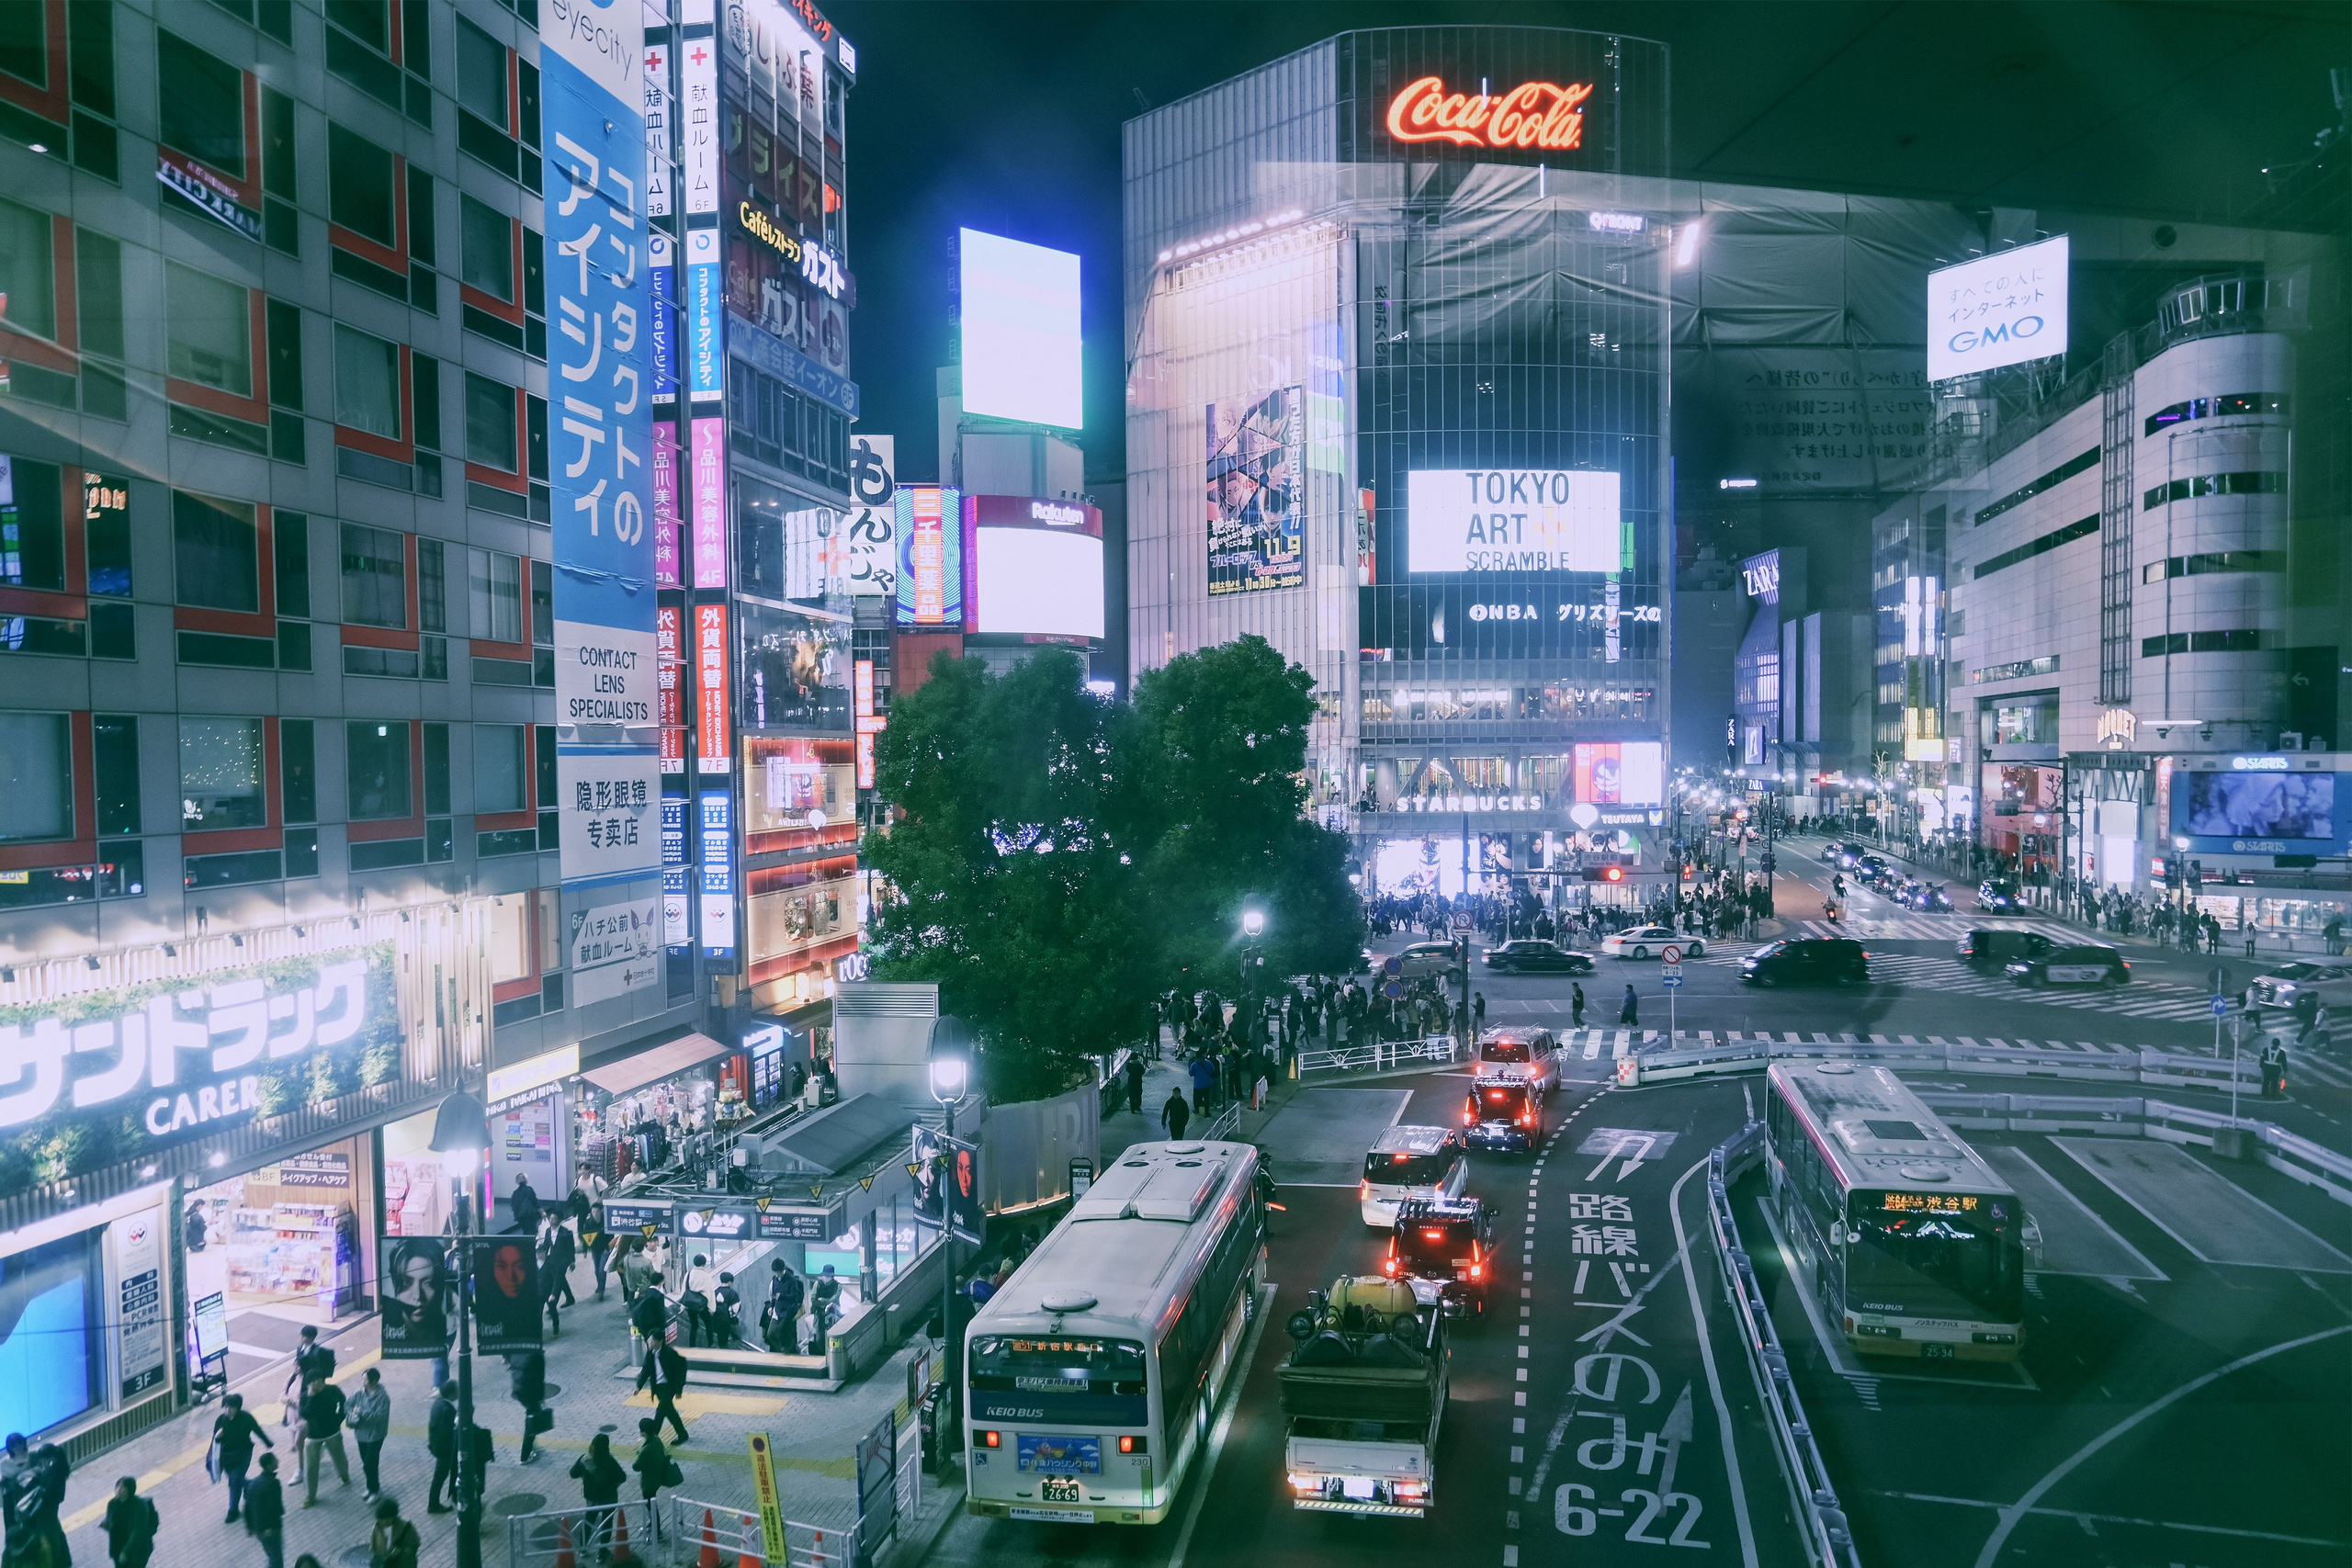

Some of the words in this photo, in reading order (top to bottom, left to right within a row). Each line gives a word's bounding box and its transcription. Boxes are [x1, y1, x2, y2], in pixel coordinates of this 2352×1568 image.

[551, 0, 632, 81] eyecity
[1387, 76, 1593, 148] Coca-Cola
[691, 84, 709, 190] 献血ルーム
[695, 199, 709, 210] 6F
[740, 201, 800, 263] Caféレストラン
[802, 240, 845, 299] ガスト
[1950, 268, 2044, 303] すべての人に
[761, 278, 815, 349] ガスト
[1949, 288, 2044, 322] インターネット
[555, 131, 607, 536] アイシティ
[698, 267, 713, 387] コンタクトのアイシティ
[1949, 316, 2044, 353] GMO
[607, 167, 642, 546] コンタクトの
[752, 333, 838, 399] 英会話イーオン
[700, 392, 712, 400] 5F
[1465, 472, 1569, 505] TOKYO
[700, 448, 718, 562] 品川美容外科
[851, 438, 895, 592] もんじゃ
[1032, 502, 1084, 525] Rakuten
[1465, 513, 1528, 545] ART
[1210, 551, 1257, 567] ブルーロック
[1465, 551, 1569, 571] SCRAMBLE
[700, 570, 721, 582] 4F
[1743, 564, 1779, 596] ZARA
[1489, 604, 1538, 620] NBA
[580, 646, 637, 670] CONTACT
[701, 608, 722, 689] 外貨両替
[594, 674, 625, 694] LENS
[570, 698, 648, 720] SPECIALISTS
[714, 690, 722, 716] MONEY
[714, 717, 723, 757] EXCHANGE
[1727, 718, 1736, 746] ZARA
[706, 760, 723, 772] 7F
[576, 779, 647, 812] 隐形眼镜
[1748, 779, 1764, 790] ZARA
[1396, 796, 1542, 811] STARBUCKS
[587, 817, 639, 849] 专卖店
[1601, 815, 1645, 825] TSUTAYA
[1584, 853, 1618, 862] 渋谷駅前
[2246, 840, 2287, 852] STARTS
[571, 914, 582, 930] 6F
[584, 915, 628, 937] ハチ公前
[581, 942, 632, 964] 献血ルーム
[714, 947, 724, 956] 3F
[0, 960, 368, 1127] サンドラッグ
[146, 1076, 261, 1136] CARER
[282, 1173, 347, 1185] メイクアップ・ヘアケア
[1928, 1196, 1978, 1211] 渋谷駅
[620, 1218, 642, 1226] 渋谷駅
[1569, 1193, 1670, 1475] 路線バスのみ
[1915, 1319, 1959, 1327] ノンステップバス
[135, 1371, 152, 1391] 3F
[987, 1406, 1015, 1416] KEIO
[1017, 1408, 1044, 1417] BUS
[1131, 1458, 1148, 1466] 230
[1555, 1483, 1711, 1549] 6-22
